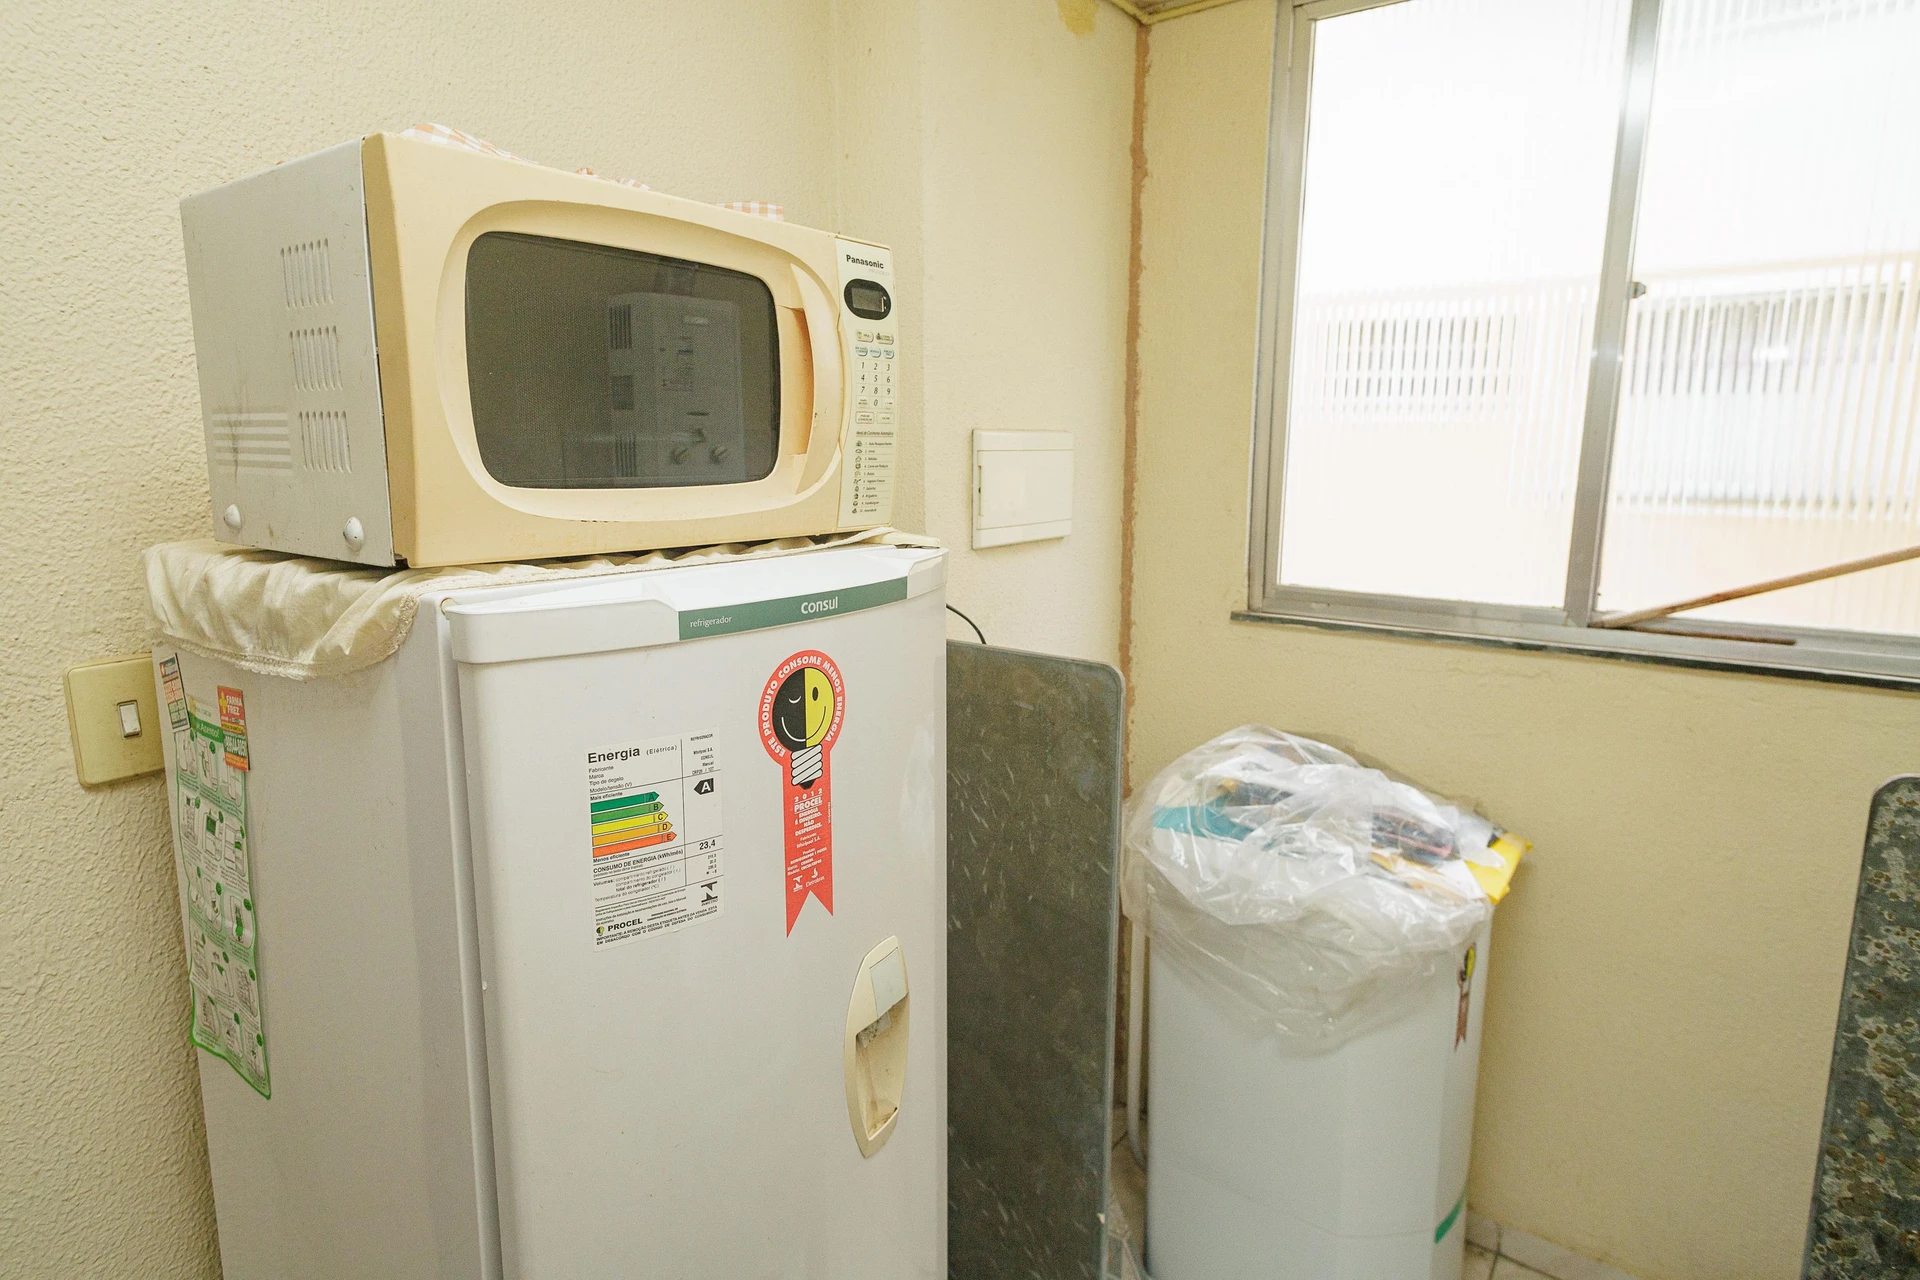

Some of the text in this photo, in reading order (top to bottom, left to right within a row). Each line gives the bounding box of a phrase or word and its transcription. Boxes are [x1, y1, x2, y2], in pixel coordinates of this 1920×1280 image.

[846, 254, 884, 269] Panasonic
[690, 615, 733, 628] refrigerador
[761, 655, 843, 758] ESTE PRODUTO CONSOME MENOS ENERGIA
[588, 745, 677, 764] Energia (Elétrica)
[588, 765, 614, 774] Fabricante
[608, 776, 624, 785] degelo
[701, 782, 711, 793] A
[603, 791, 623, 799] eficiente
[648, 793, 655, 801] A
[794, 797, 823, 813] PROCEL
[662, 823, 668, 831] D
[667, 833, 672, 841] E
[699, 839, 716, 851] 23,4
[593, 863, 622, 874] CONSUMO
[632, 855, 656, 865] ENERGIA
[608, 918, 643, 932] PROCEL
